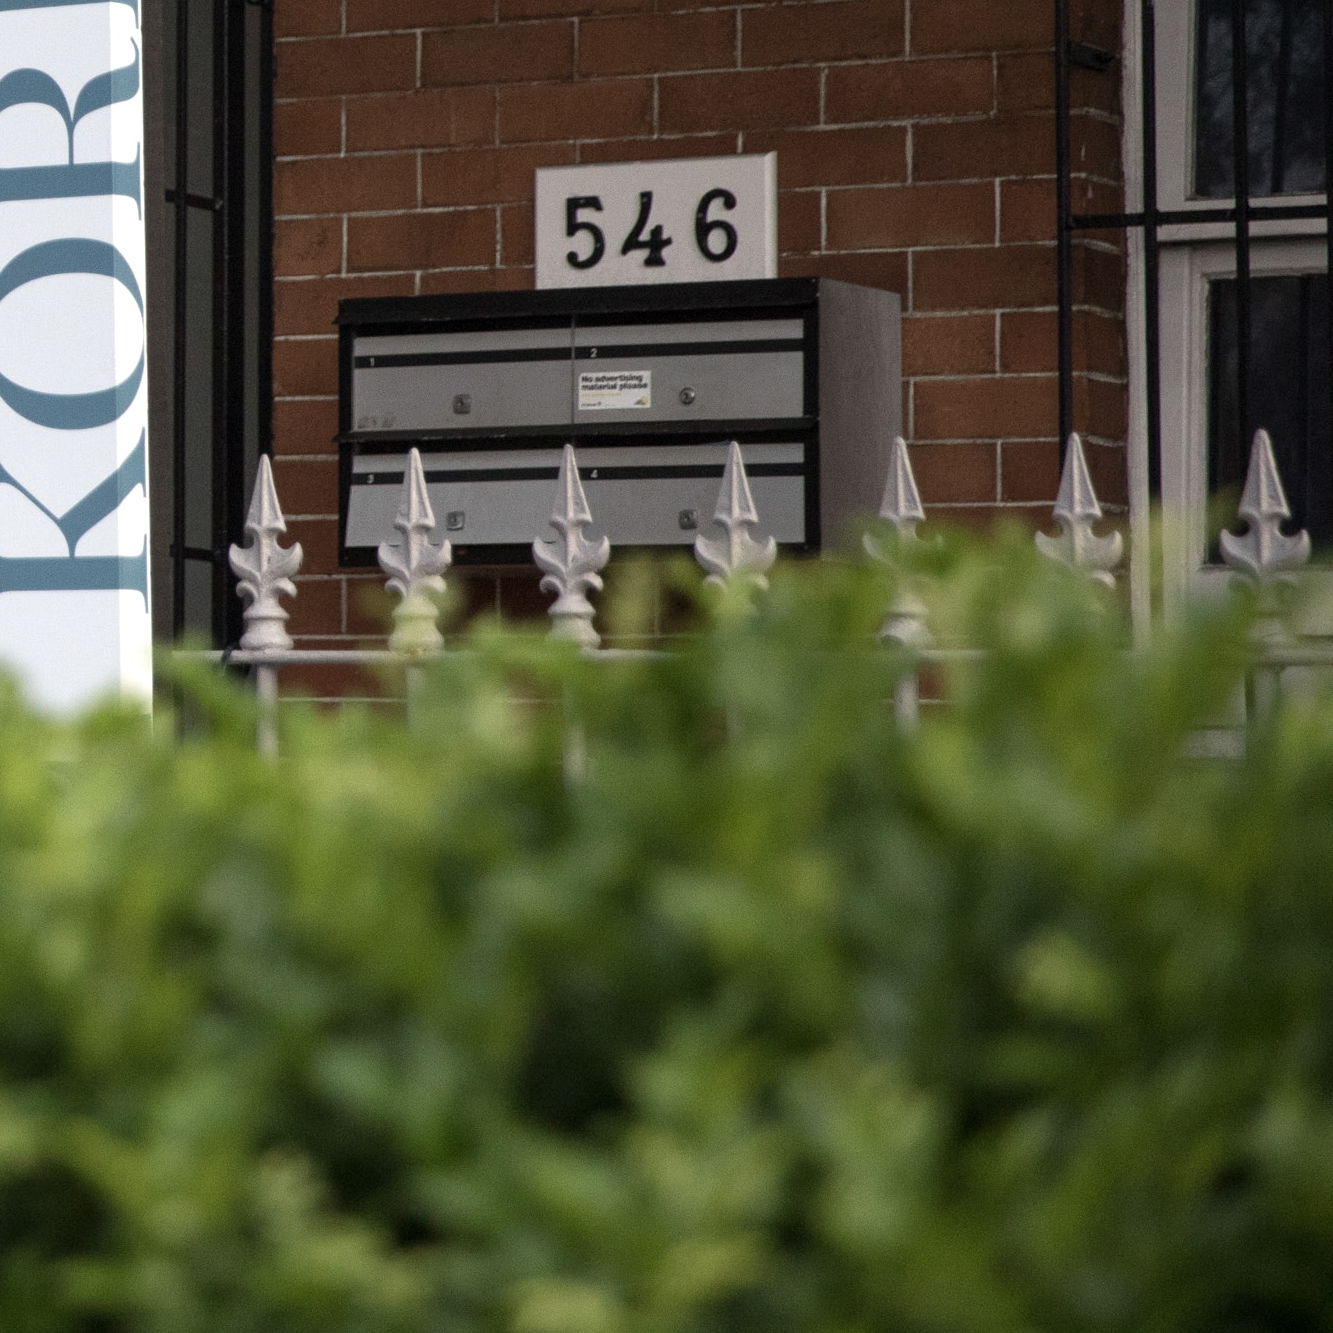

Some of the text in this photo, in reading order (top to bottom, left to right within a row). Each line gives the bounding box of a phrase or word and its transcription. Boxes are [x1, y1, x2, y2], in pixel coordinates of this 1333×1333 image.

[565, 188, 738, 270] 546
[590, 348, 598, 358] 2
[595, 373, 644, 383] advertising
[581, 382, 648, 391] material please
